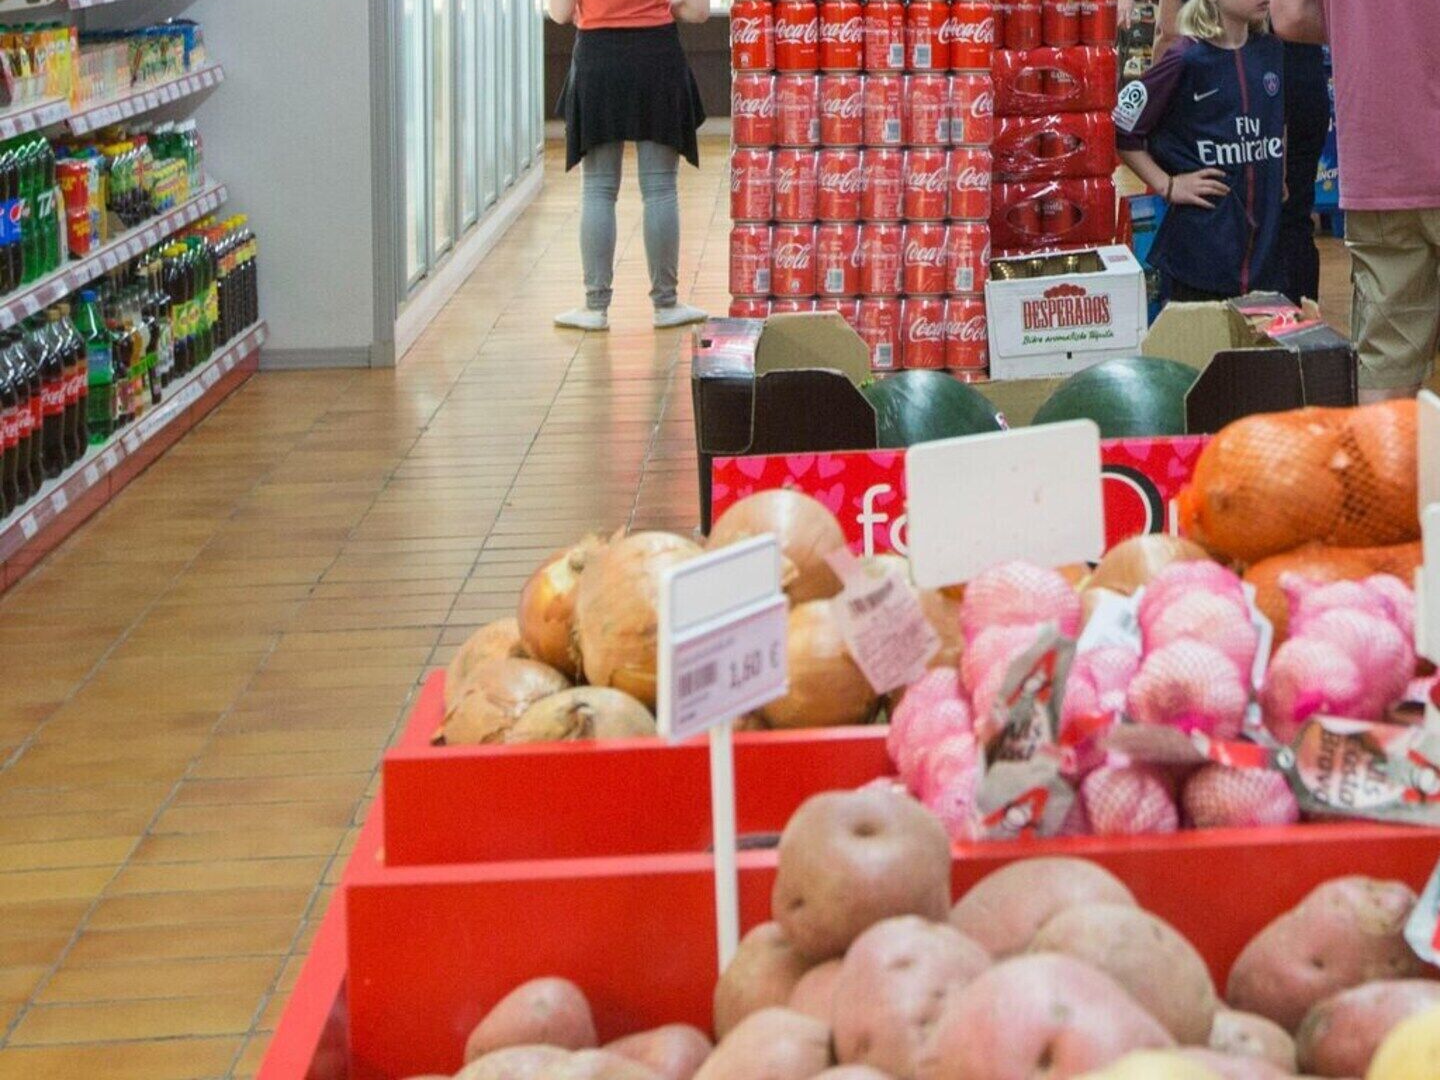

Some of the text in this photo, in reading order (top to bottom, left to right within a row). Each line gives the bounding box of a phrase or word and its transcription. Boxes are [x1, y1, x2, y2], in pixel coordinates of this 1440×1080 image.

[1235, 117, 1261, 137] Fly
[1197, 137, 1283, 166] Emirate
[1023, 294, 1110, 329] DESPERADOS
